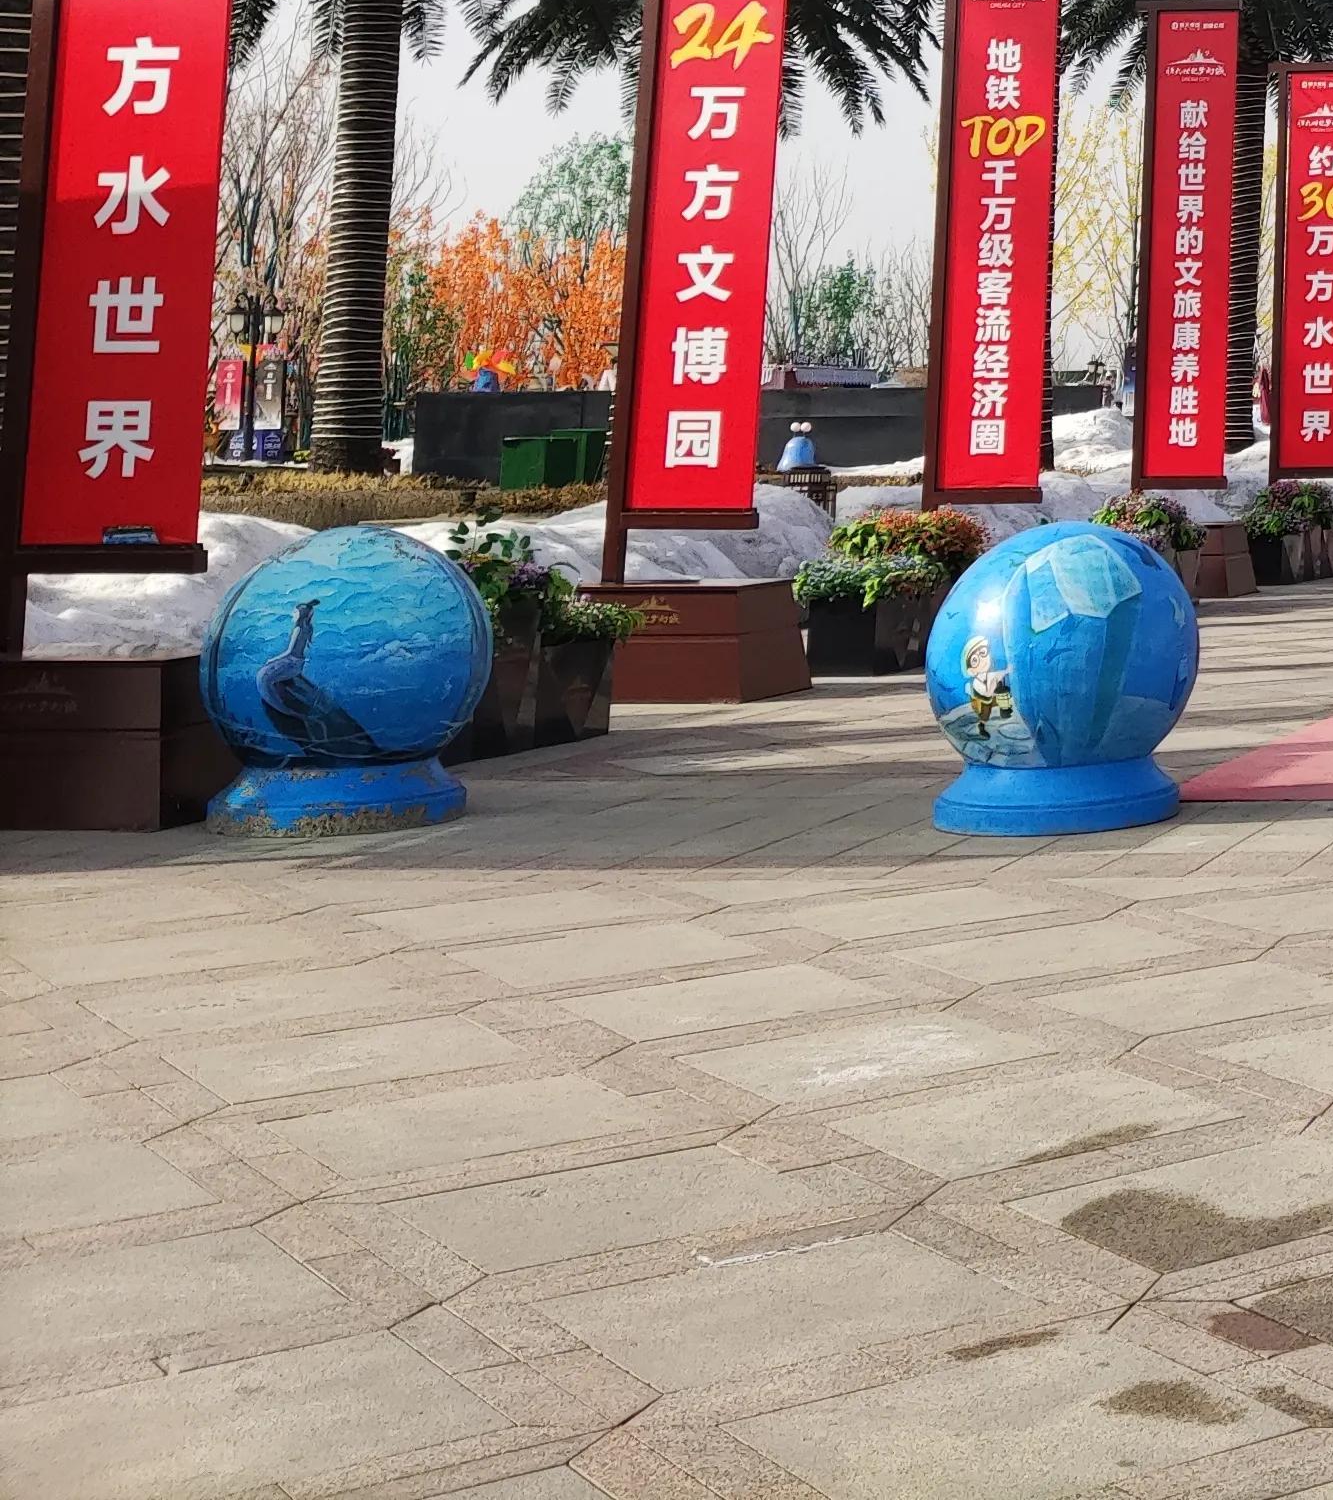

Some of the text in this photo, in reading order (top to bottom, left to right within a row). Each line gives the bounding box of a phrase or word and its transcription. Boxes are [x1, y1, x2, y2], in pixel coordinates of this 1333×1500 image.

[962, 39, 1045, 455] 地铁TOD千万级客流经济圈
[1169, 100, 1208, 446] 献给世界的文旅康养胜地
